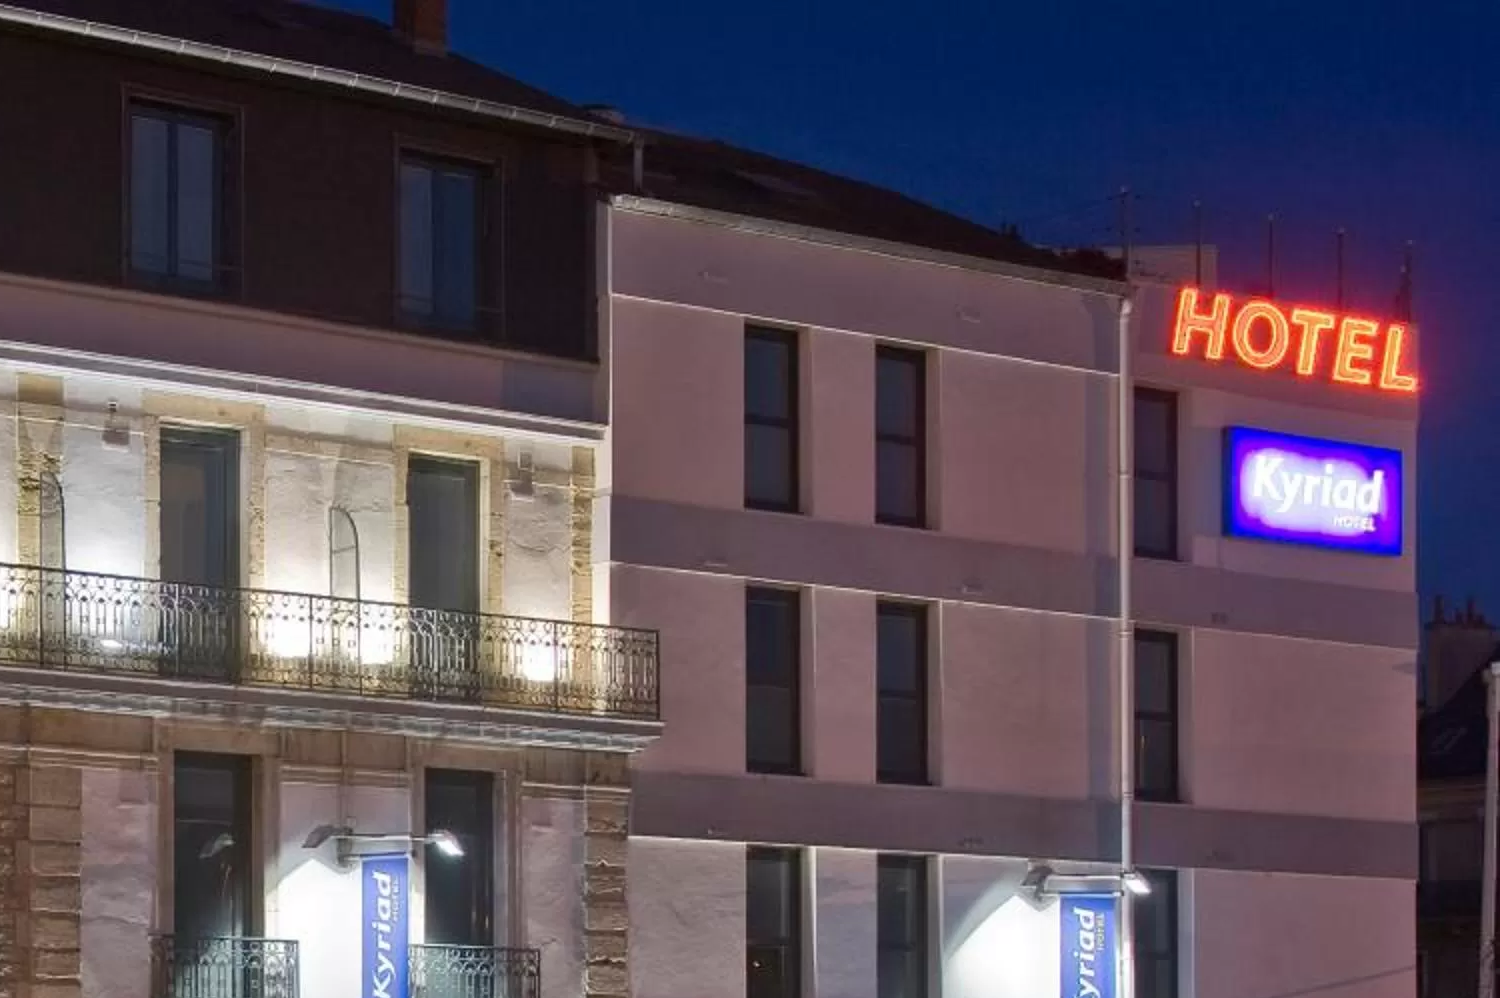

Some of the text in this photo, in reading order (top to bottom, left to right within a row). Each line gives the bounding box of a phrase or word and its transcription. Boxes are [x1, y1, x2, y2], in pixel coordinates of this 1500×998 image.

[1173, 288, 1417, 392] HOTEL
[1252, 455, 1384, 513] Kyriad
[1334, 515, 1376, 532] HOTEL
